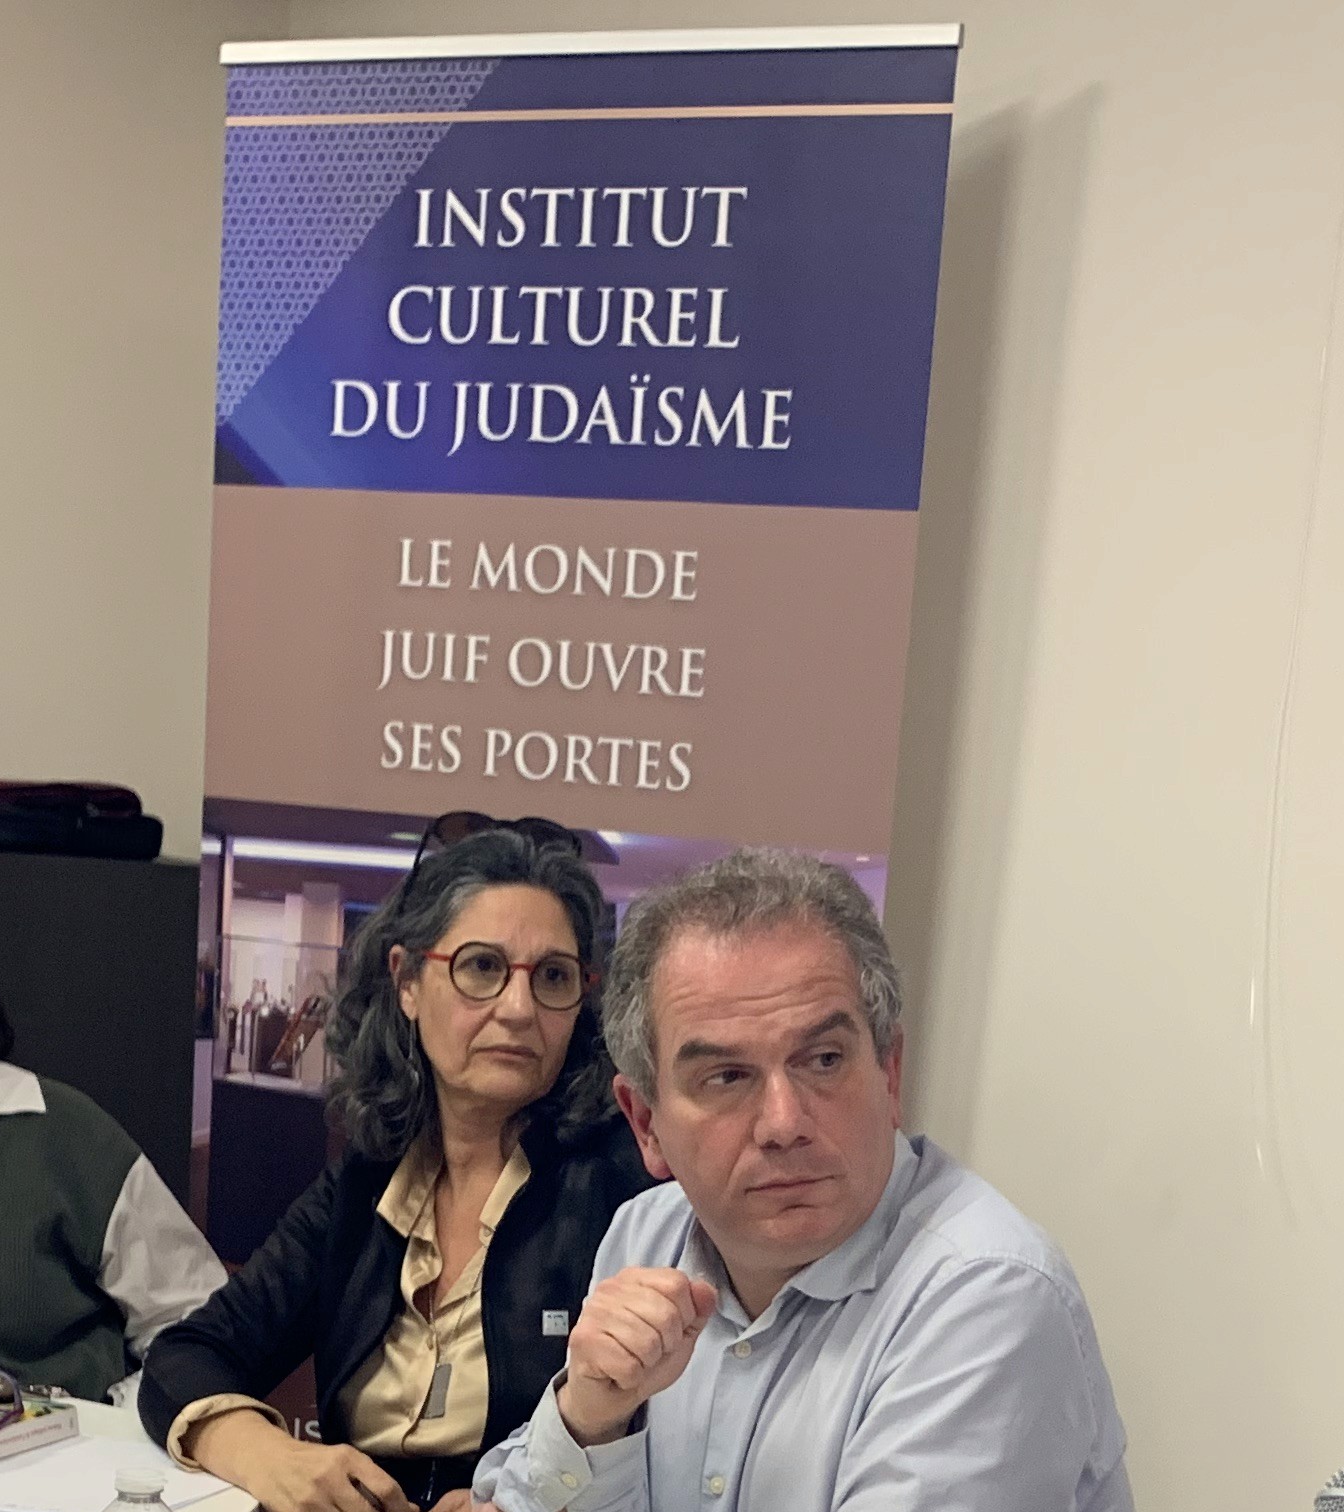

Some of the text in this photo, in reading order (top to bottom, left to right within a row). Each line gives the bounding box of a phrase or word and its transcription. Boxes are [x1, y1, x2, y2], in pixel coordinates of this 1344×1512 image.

[415, 186, 748, 250] INSTITUT
[387, 285, 739, 350] CULTUREL
[329, 373, 794, 457] DU JUDAÏSME
[398, 537, 700, 602] LE MONDE
[377, 628, 707, 698] JUIF OUVRE
[380, 722, 694, 793] SES PORTES
